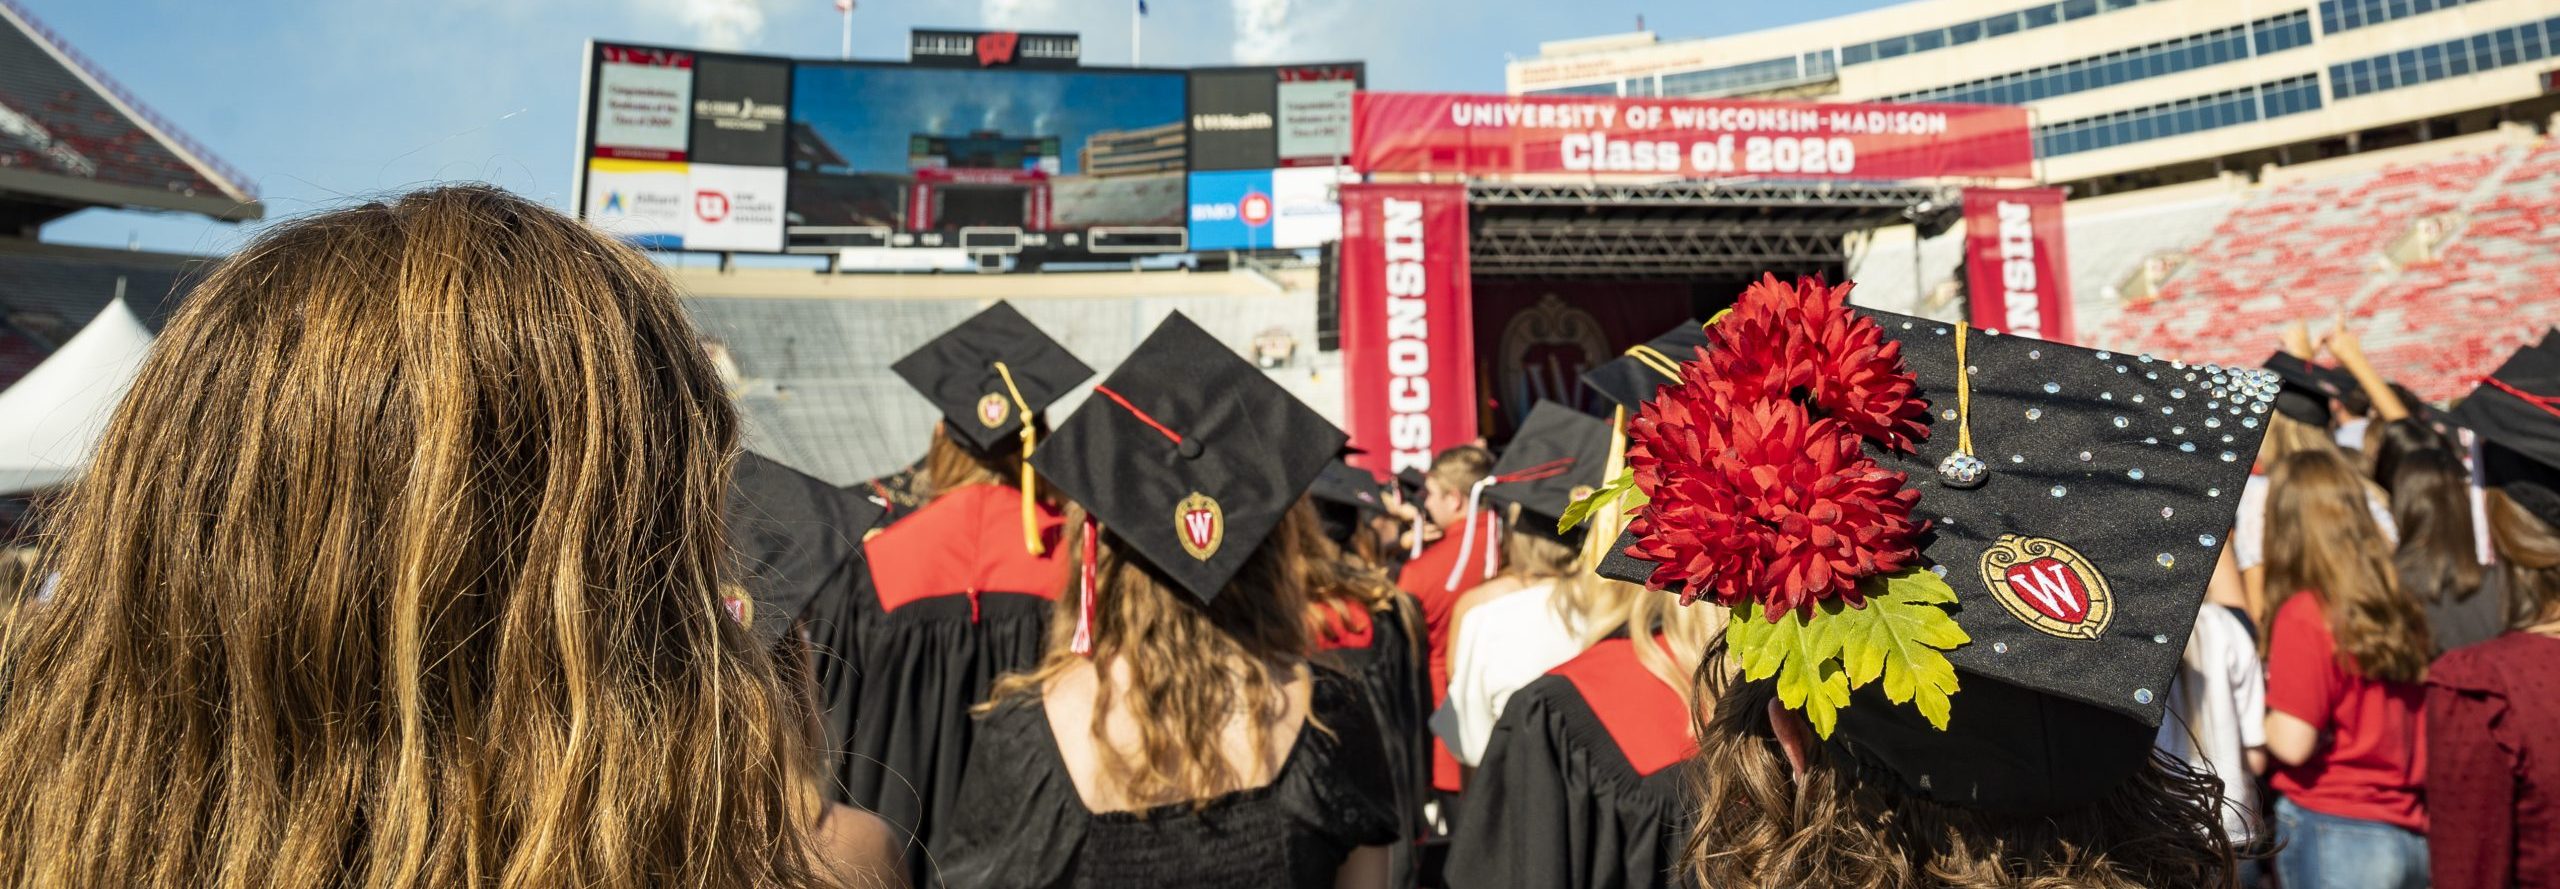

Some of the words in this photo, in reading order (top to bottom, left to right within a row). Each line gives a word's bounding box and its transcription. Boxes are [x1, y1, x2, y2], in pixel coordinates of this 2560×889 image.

[1452, 102, 1617, 128] UNIVERSITY
[1625, 105, 1663, 129] OF
[1670, 106, 1947, 134] WISCONSIN-MADISON
[1560, 132, 1681, 171] Class
[1691, 134, 1735, 172] of
[1745, 136, 1855, 173] 2020
[1997, 200, 2042, 339] NSIN
[1382, 196, 1432, 475] ISCONSIN
[1186, 511, 1212, 544] W
[2009, 563, 2081, 617] W
